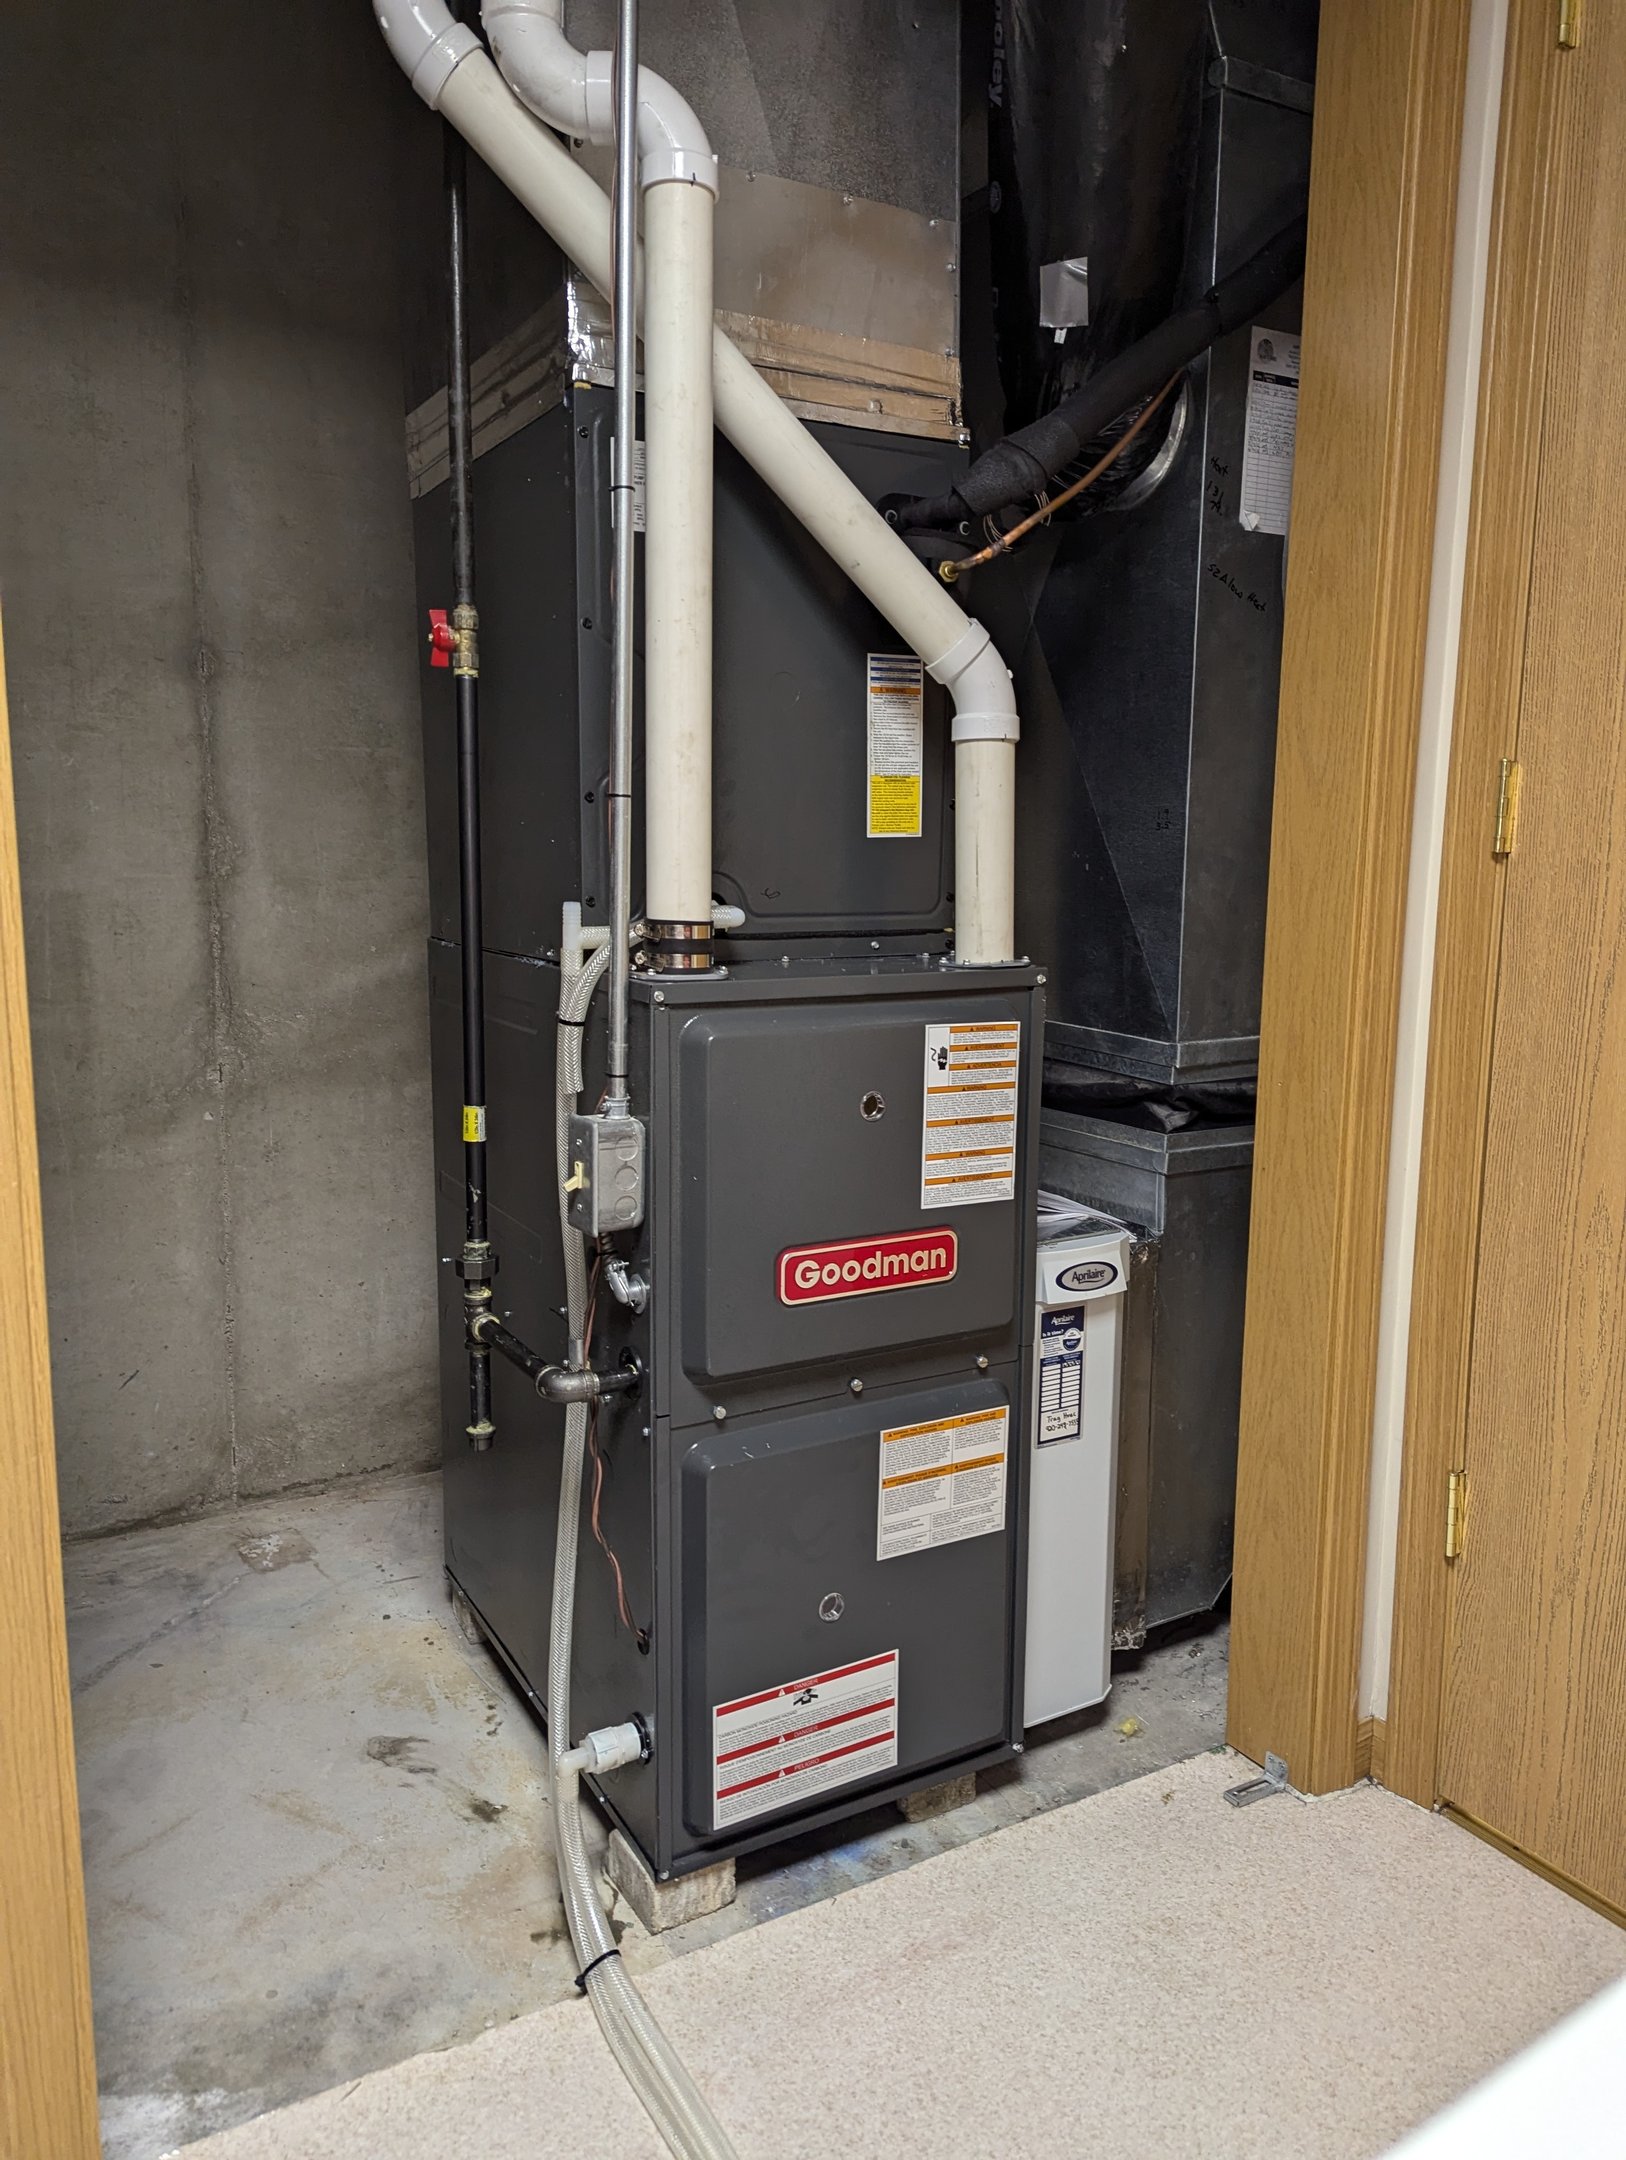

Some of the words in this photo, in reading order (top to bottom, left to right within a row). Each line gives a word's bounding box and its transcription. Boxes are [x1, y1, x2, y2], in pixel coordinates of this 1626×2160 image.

[794, 1247, 947, 1290] Goodman
[1072, 1266, 1106, 1283] Aprilaire
[793, 1678, 819, 1690] DANGER
[793, 1725, 819, 1738] DANGER
[794, 1758, 820, 1771] PELIGRO
